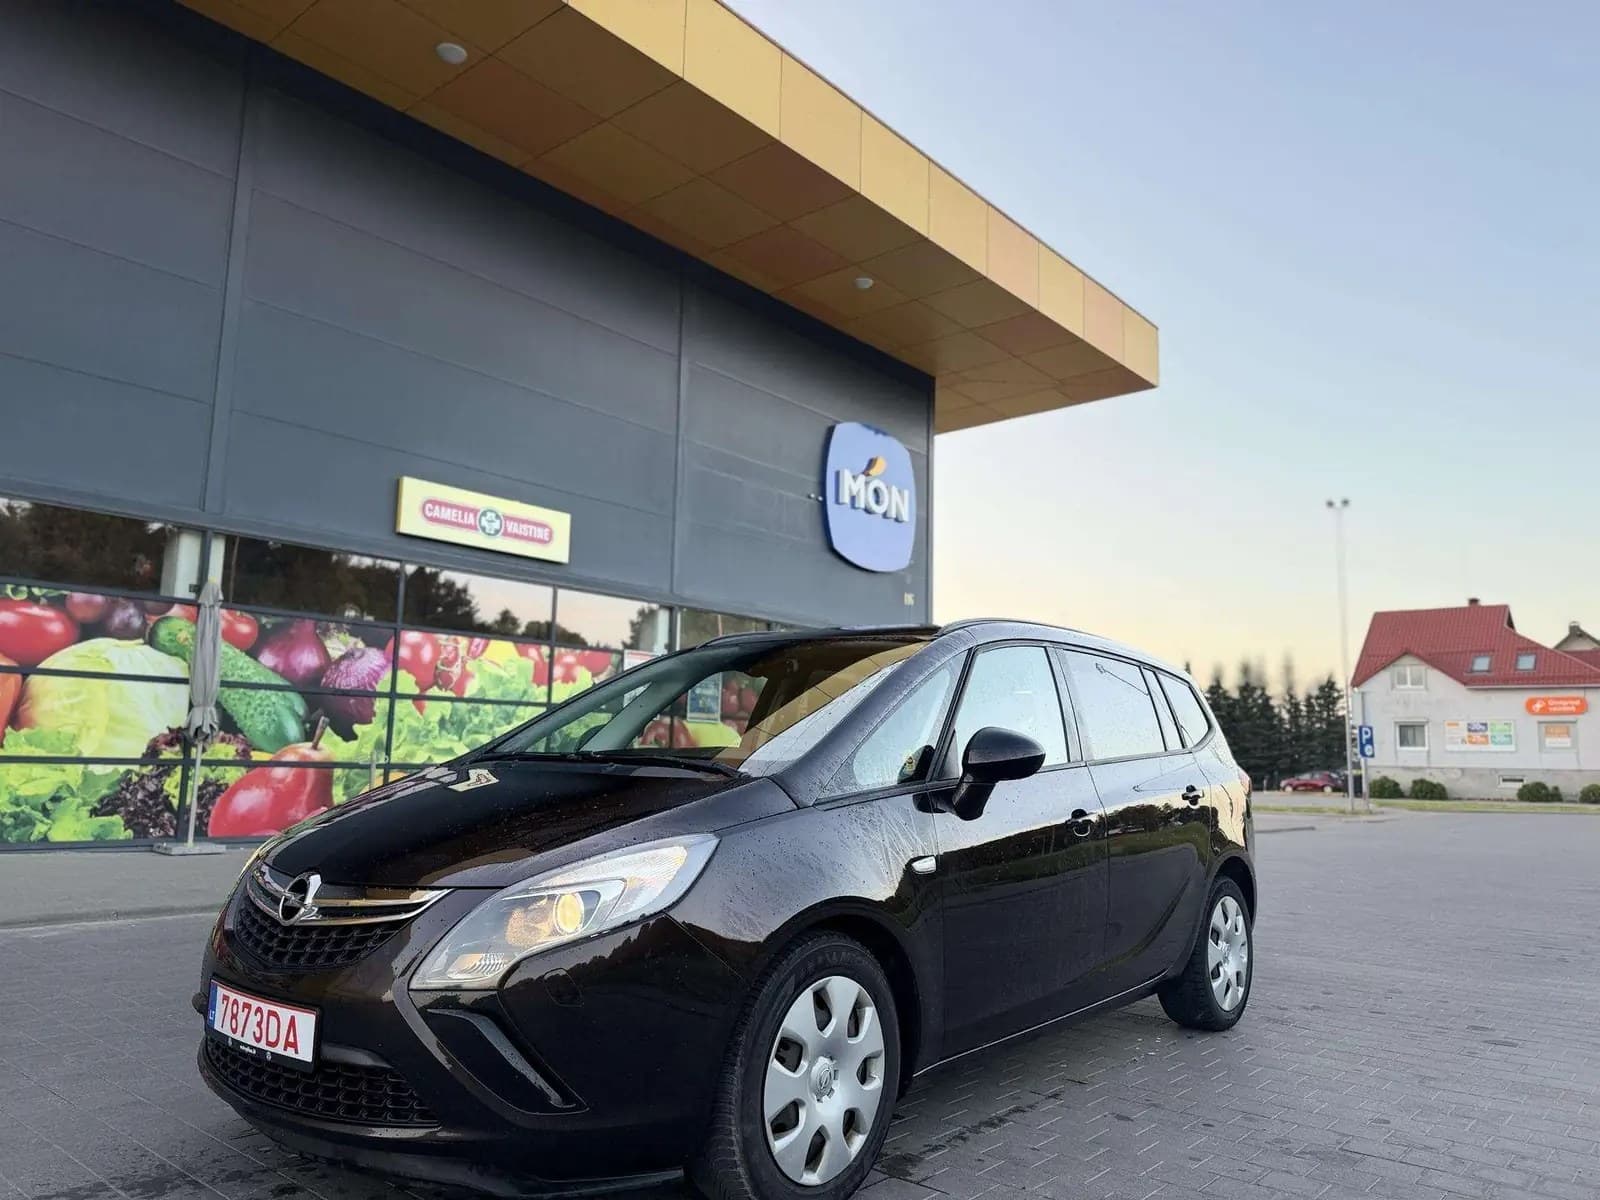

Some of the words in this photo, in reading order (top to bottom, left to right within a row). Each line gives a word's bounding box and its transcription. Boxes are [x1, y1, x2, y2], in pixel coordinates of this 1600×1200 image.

[837, 468, 910, 523] MON
[424, 502, 475, 526] CAMELIA
[1361, 726, 1371, 745] P
[208, 1010, 216, 1021] LT
[221, 993, 299, 1054] 7873DA
